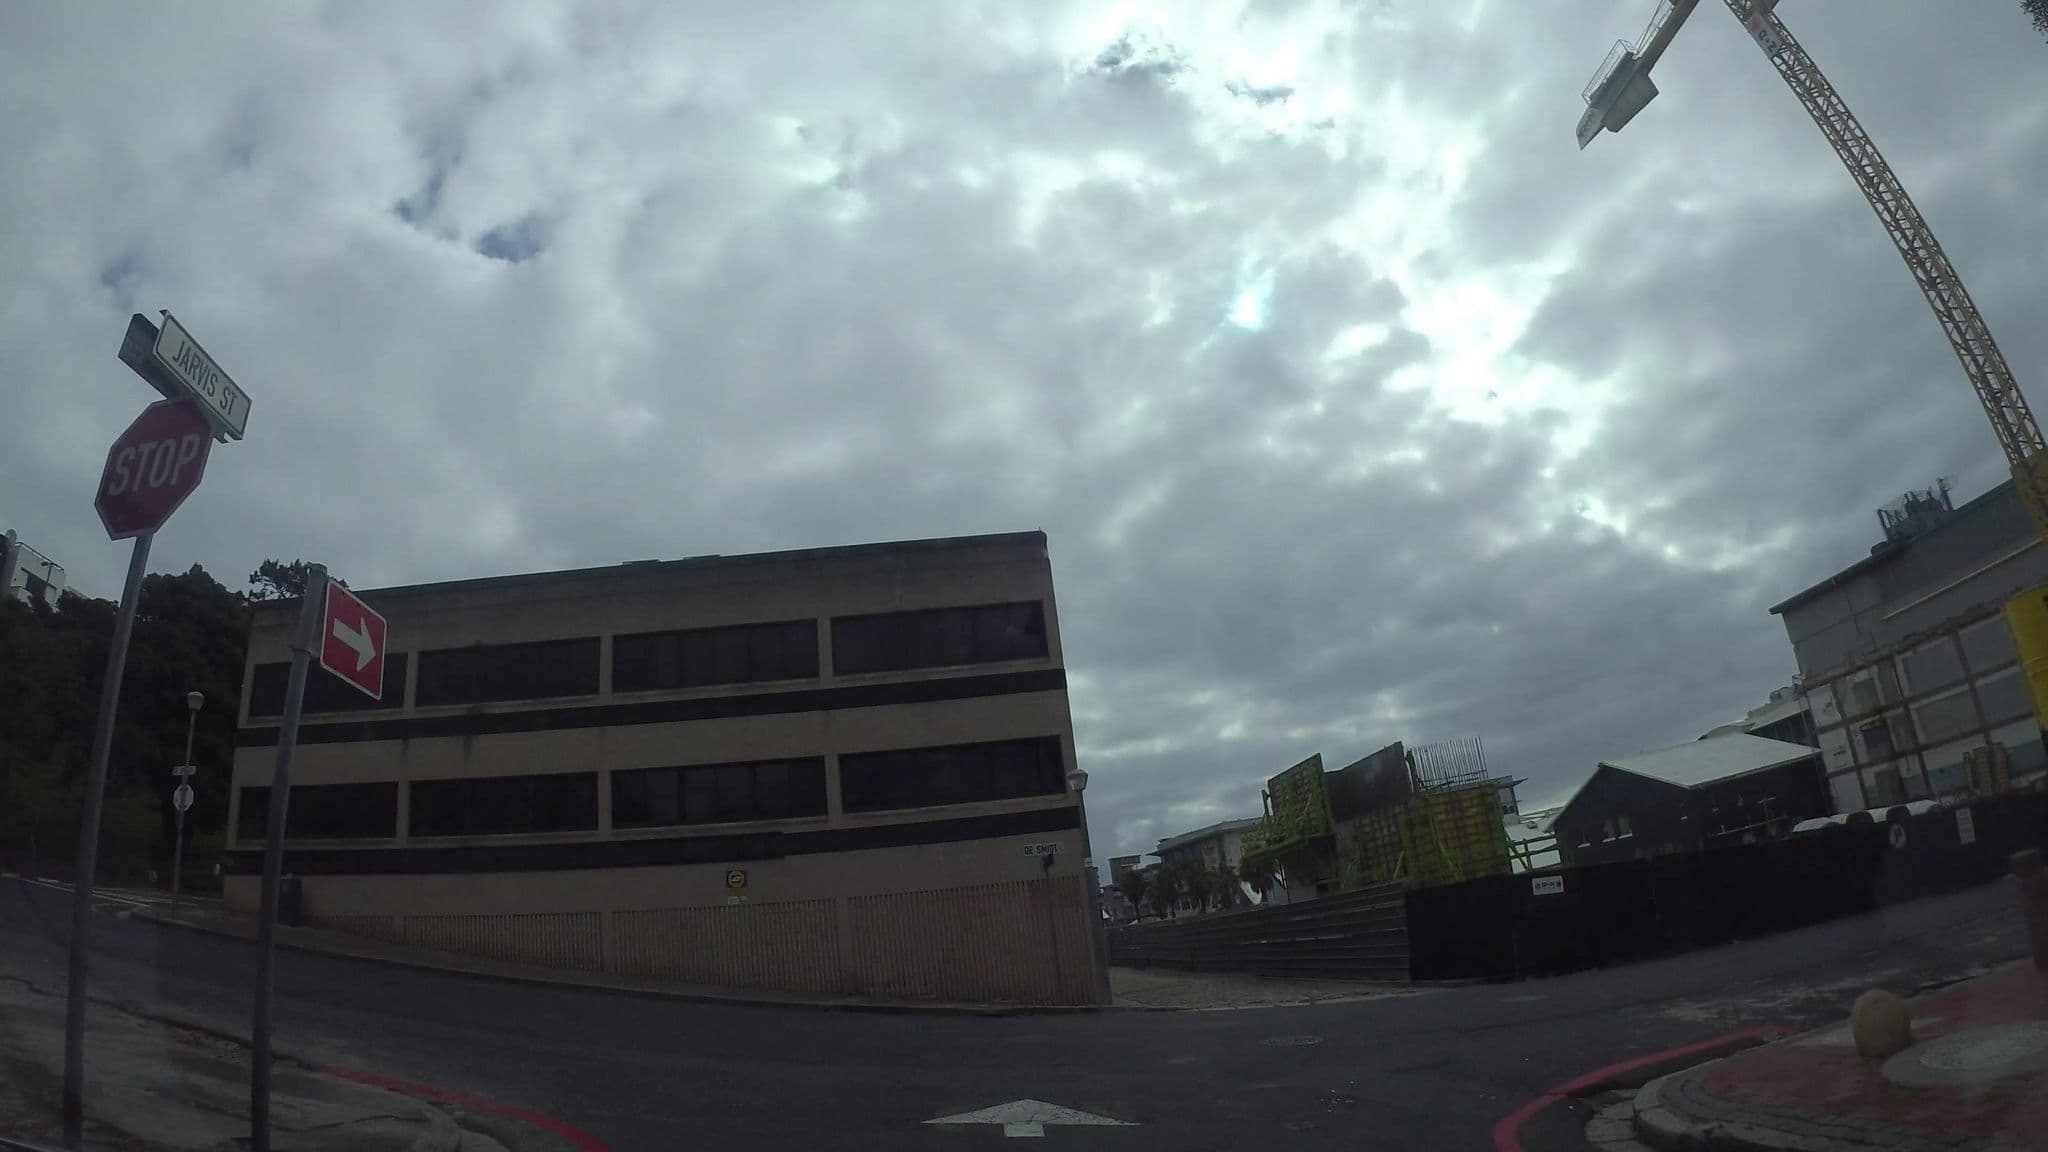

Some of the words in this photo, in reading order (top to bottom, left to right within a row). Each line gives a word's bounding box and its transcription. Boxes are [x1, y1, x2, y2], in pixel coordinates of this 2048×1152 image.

[172, 340, 218, 398] JARVIS
[219, 386, 238, 416] ST
[108, 433, 200, 496] STOP
[1024, 845, 1033, 855] DE
